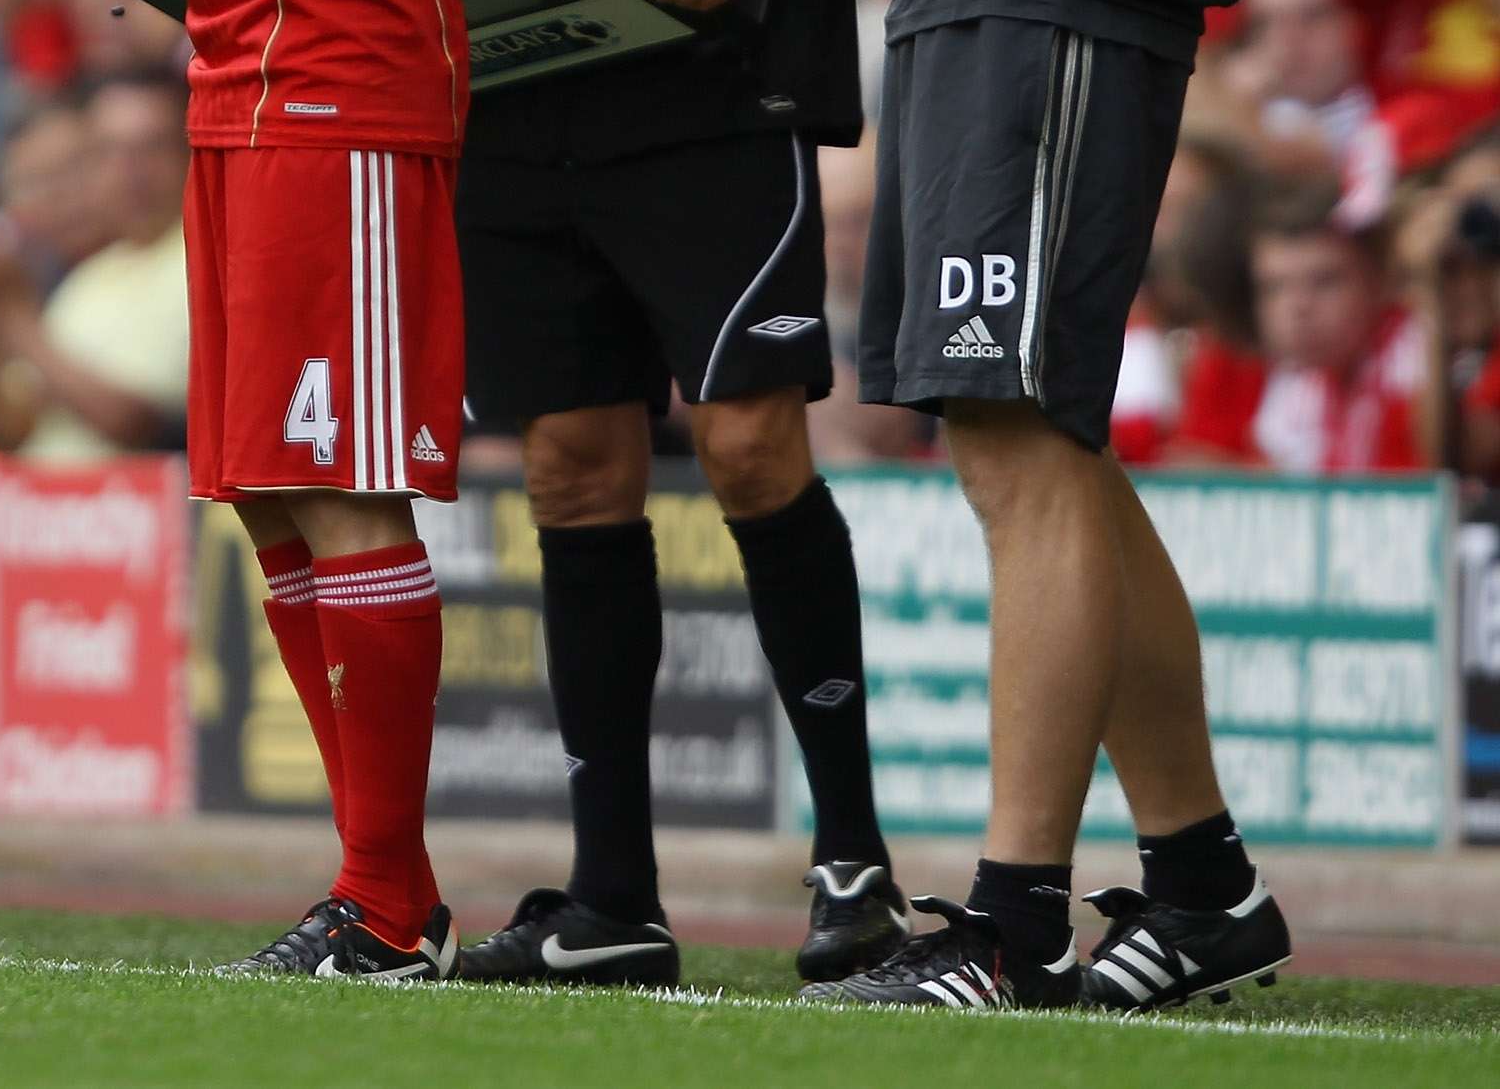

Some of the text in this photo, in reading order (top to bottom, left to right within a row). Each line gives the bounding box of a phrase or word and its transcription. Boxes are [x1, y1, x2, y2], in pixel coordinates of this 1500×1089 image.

[470, 26, 562, 62] RCLAYS
[938, 254, 1016, 309] DB
[942, 343, 1004, 358] adidas
[284, 358, 338, 464] 4
[411, 445, 445, 462] adidas
